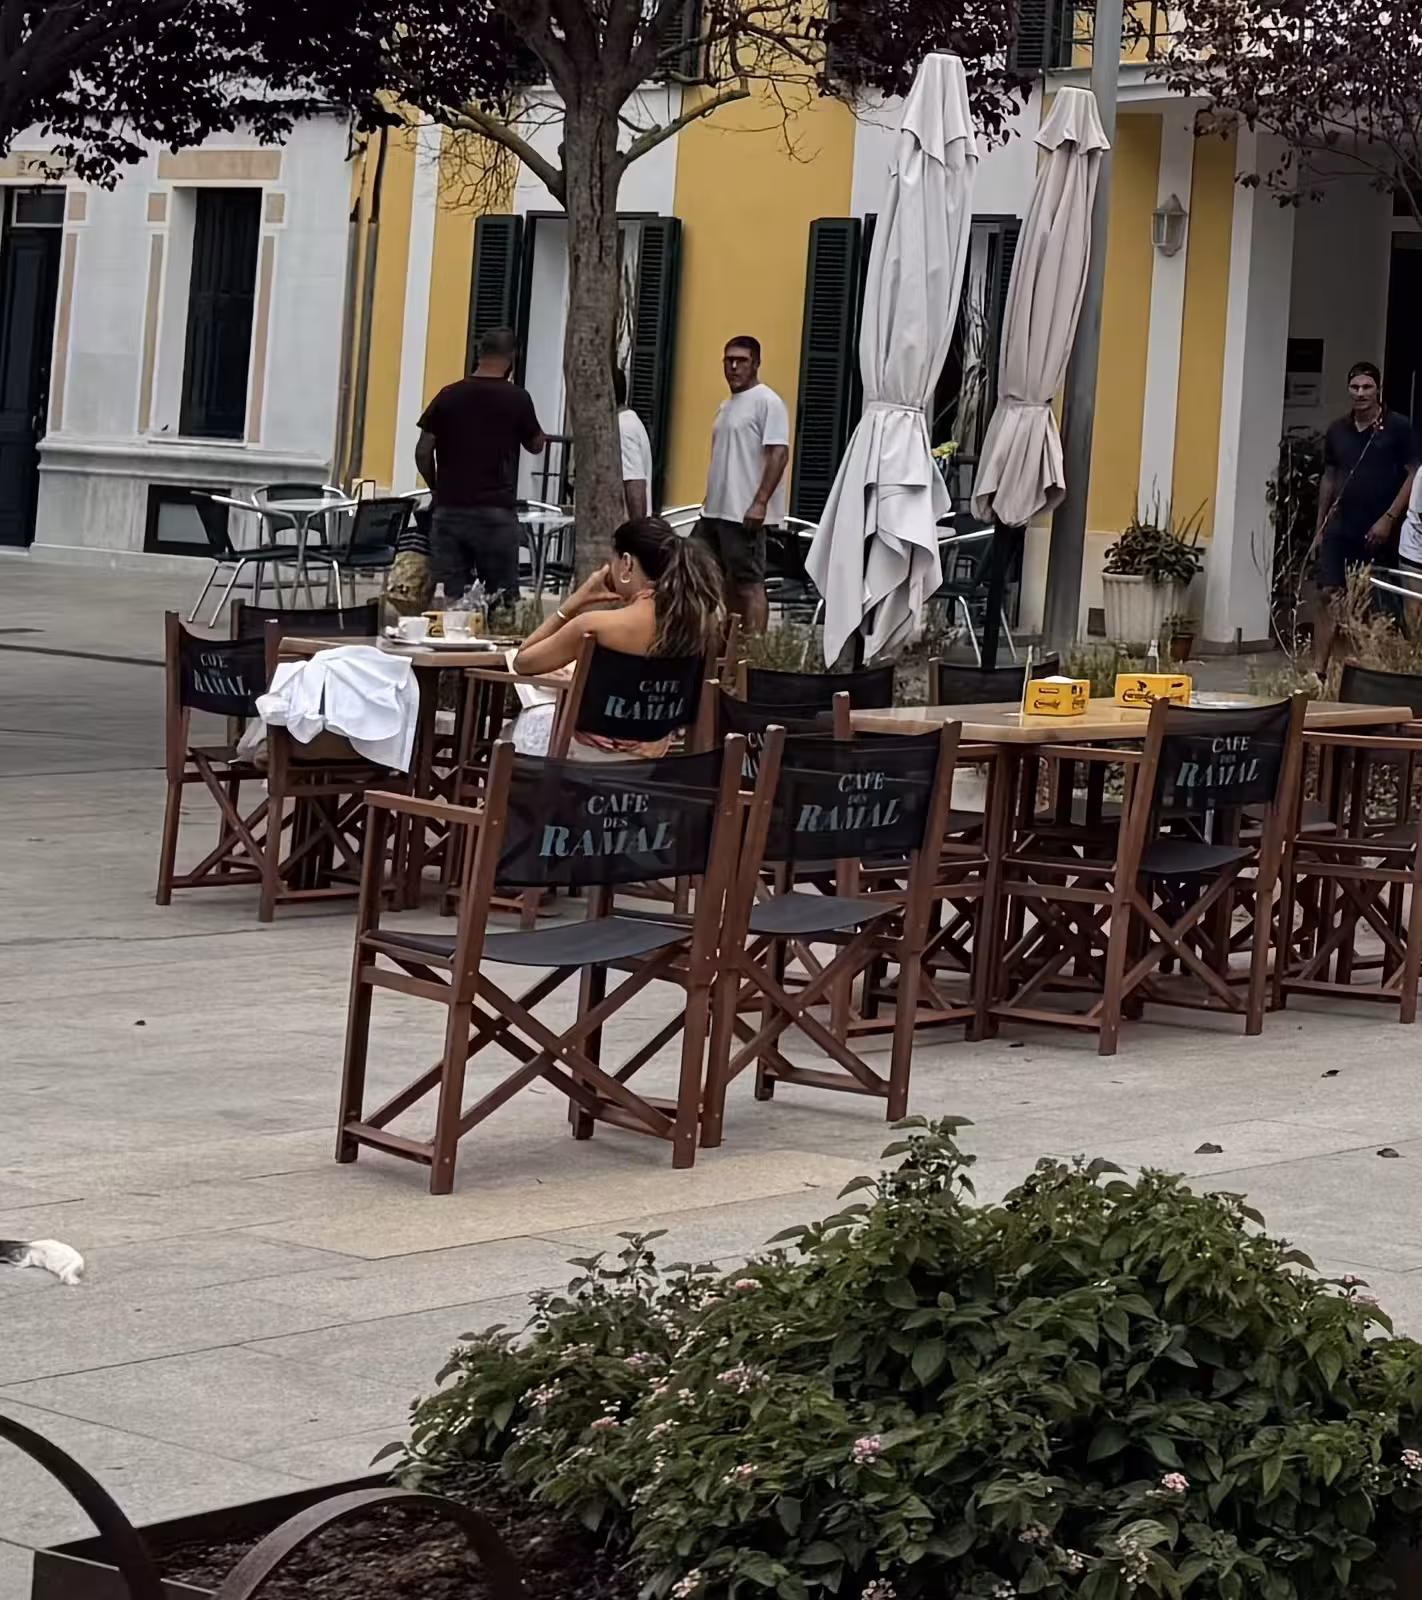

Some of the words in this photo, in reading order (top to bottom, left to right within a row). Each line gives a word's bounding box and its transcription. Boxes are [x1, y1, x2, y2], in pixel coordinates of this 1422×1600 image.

[1211, 736, 1251, 753] CAFE
[838, 772, 885, 793] CAFE
[1176, 758, 1261, 787] RAMAL
[586, 793, 650, 815] CAFE
[795, 798, 902, 832] RAMAL
[602, 816, 629, 829] DES
[538, 821, 675, 857] RAMAL
